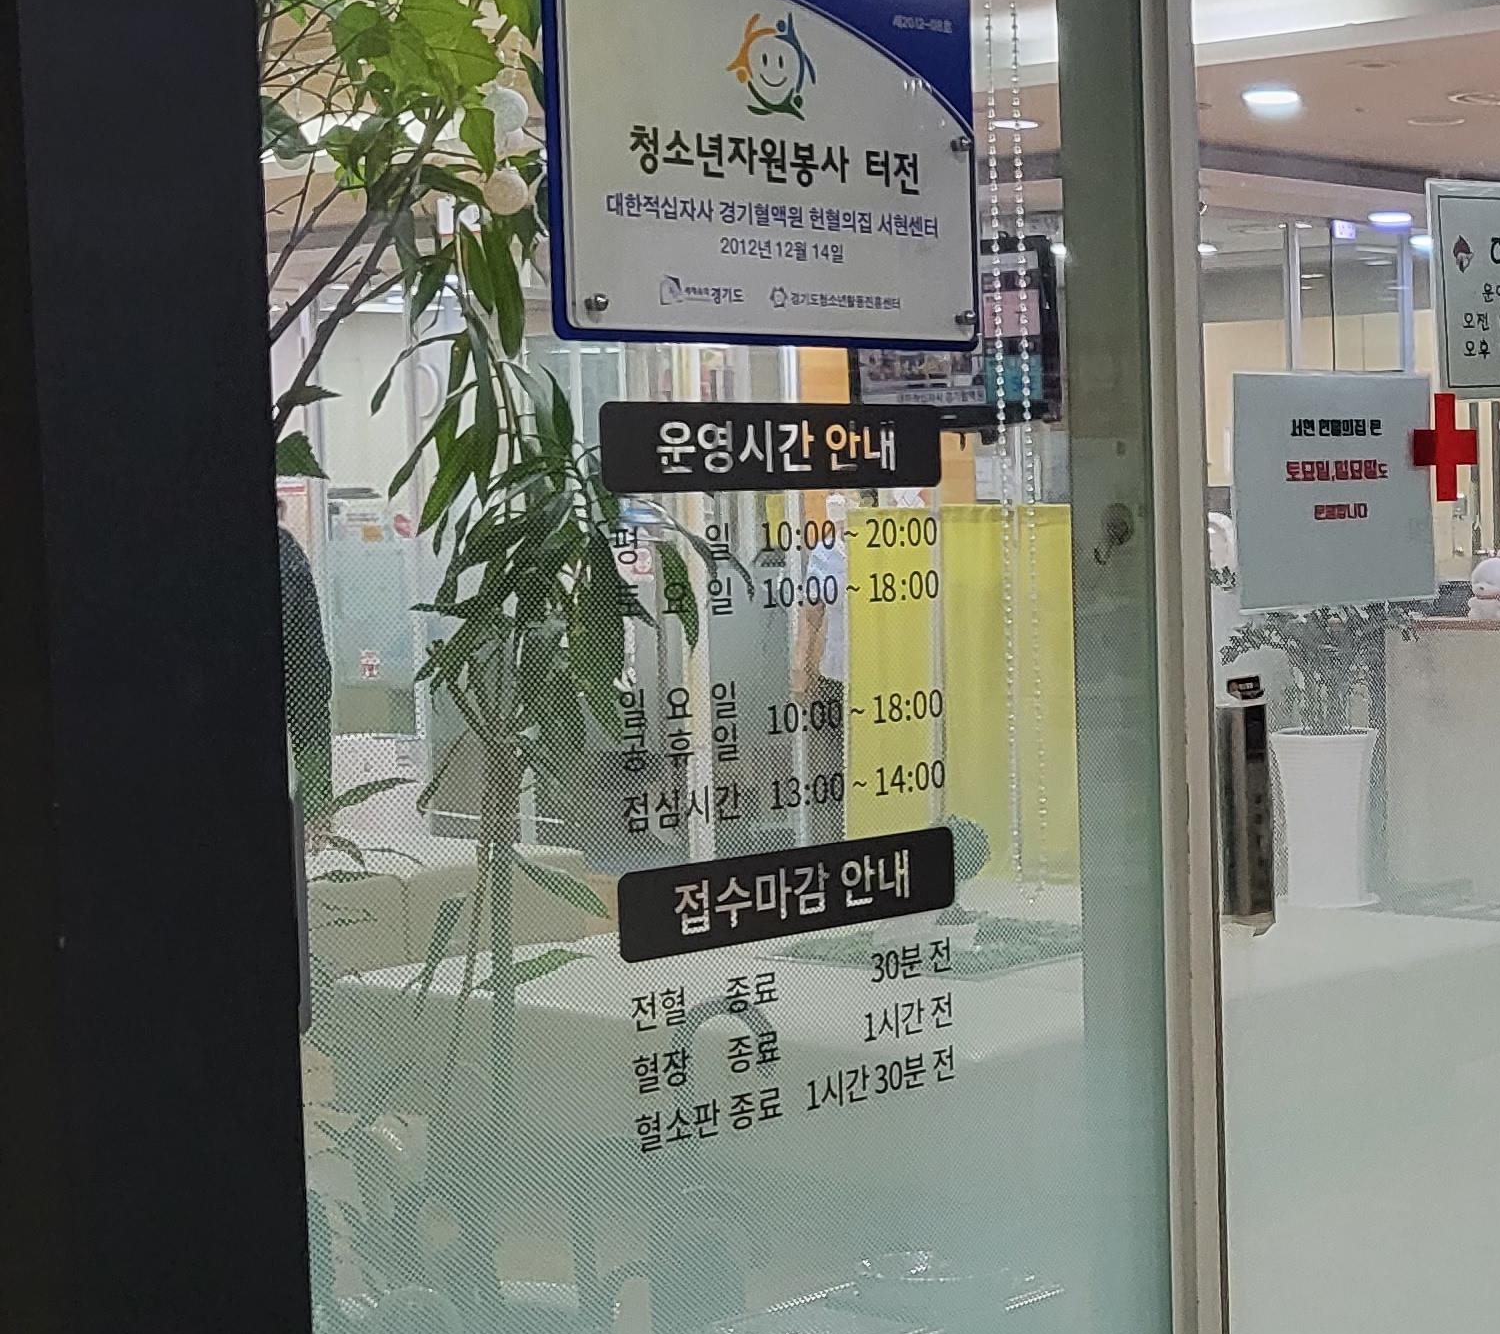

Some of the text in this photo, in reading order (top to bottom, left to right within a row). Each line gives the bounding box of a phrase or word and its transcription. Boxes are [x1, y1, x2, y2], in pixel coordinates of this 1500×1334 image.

[628, 124, 921, 196] 청소년자원봉사 터전
[606, 193, 939, 239] 대한적십자사 경기혈액원 헌혈의집 서현센터
[719, 236, 845, 264] 2012년 12월 14일
[710, 287, 745, 305] 경기도
[1462, 312, 1490, 332] 오전
[1463, 340, 1491, 359] 오후
[656, 419, 897, 475] 운영시간 안내
[761, 520, 836, 552] 10:00
[866, 517, 938, 548] 20:00
[763, 575, 838, 609] 10:00
[868, 570, 940, 603] 18:00
[767, 701, 843, 736] 10:00
[873, 688, 944, 724] 18:00
[622, 759, 946, 835] 점심시간 13:00 14:00
[673, 848, 911, 936] 접수마감 안내
[631, 986, 687, 1032] 전혈
[726, 971, 779, 1014] 종료
[633, 992, 954, 1095] 혈장 종료 1시간 전
[634, 1044, 955, 1154] 혈소판 종료 1시간 30분 전
